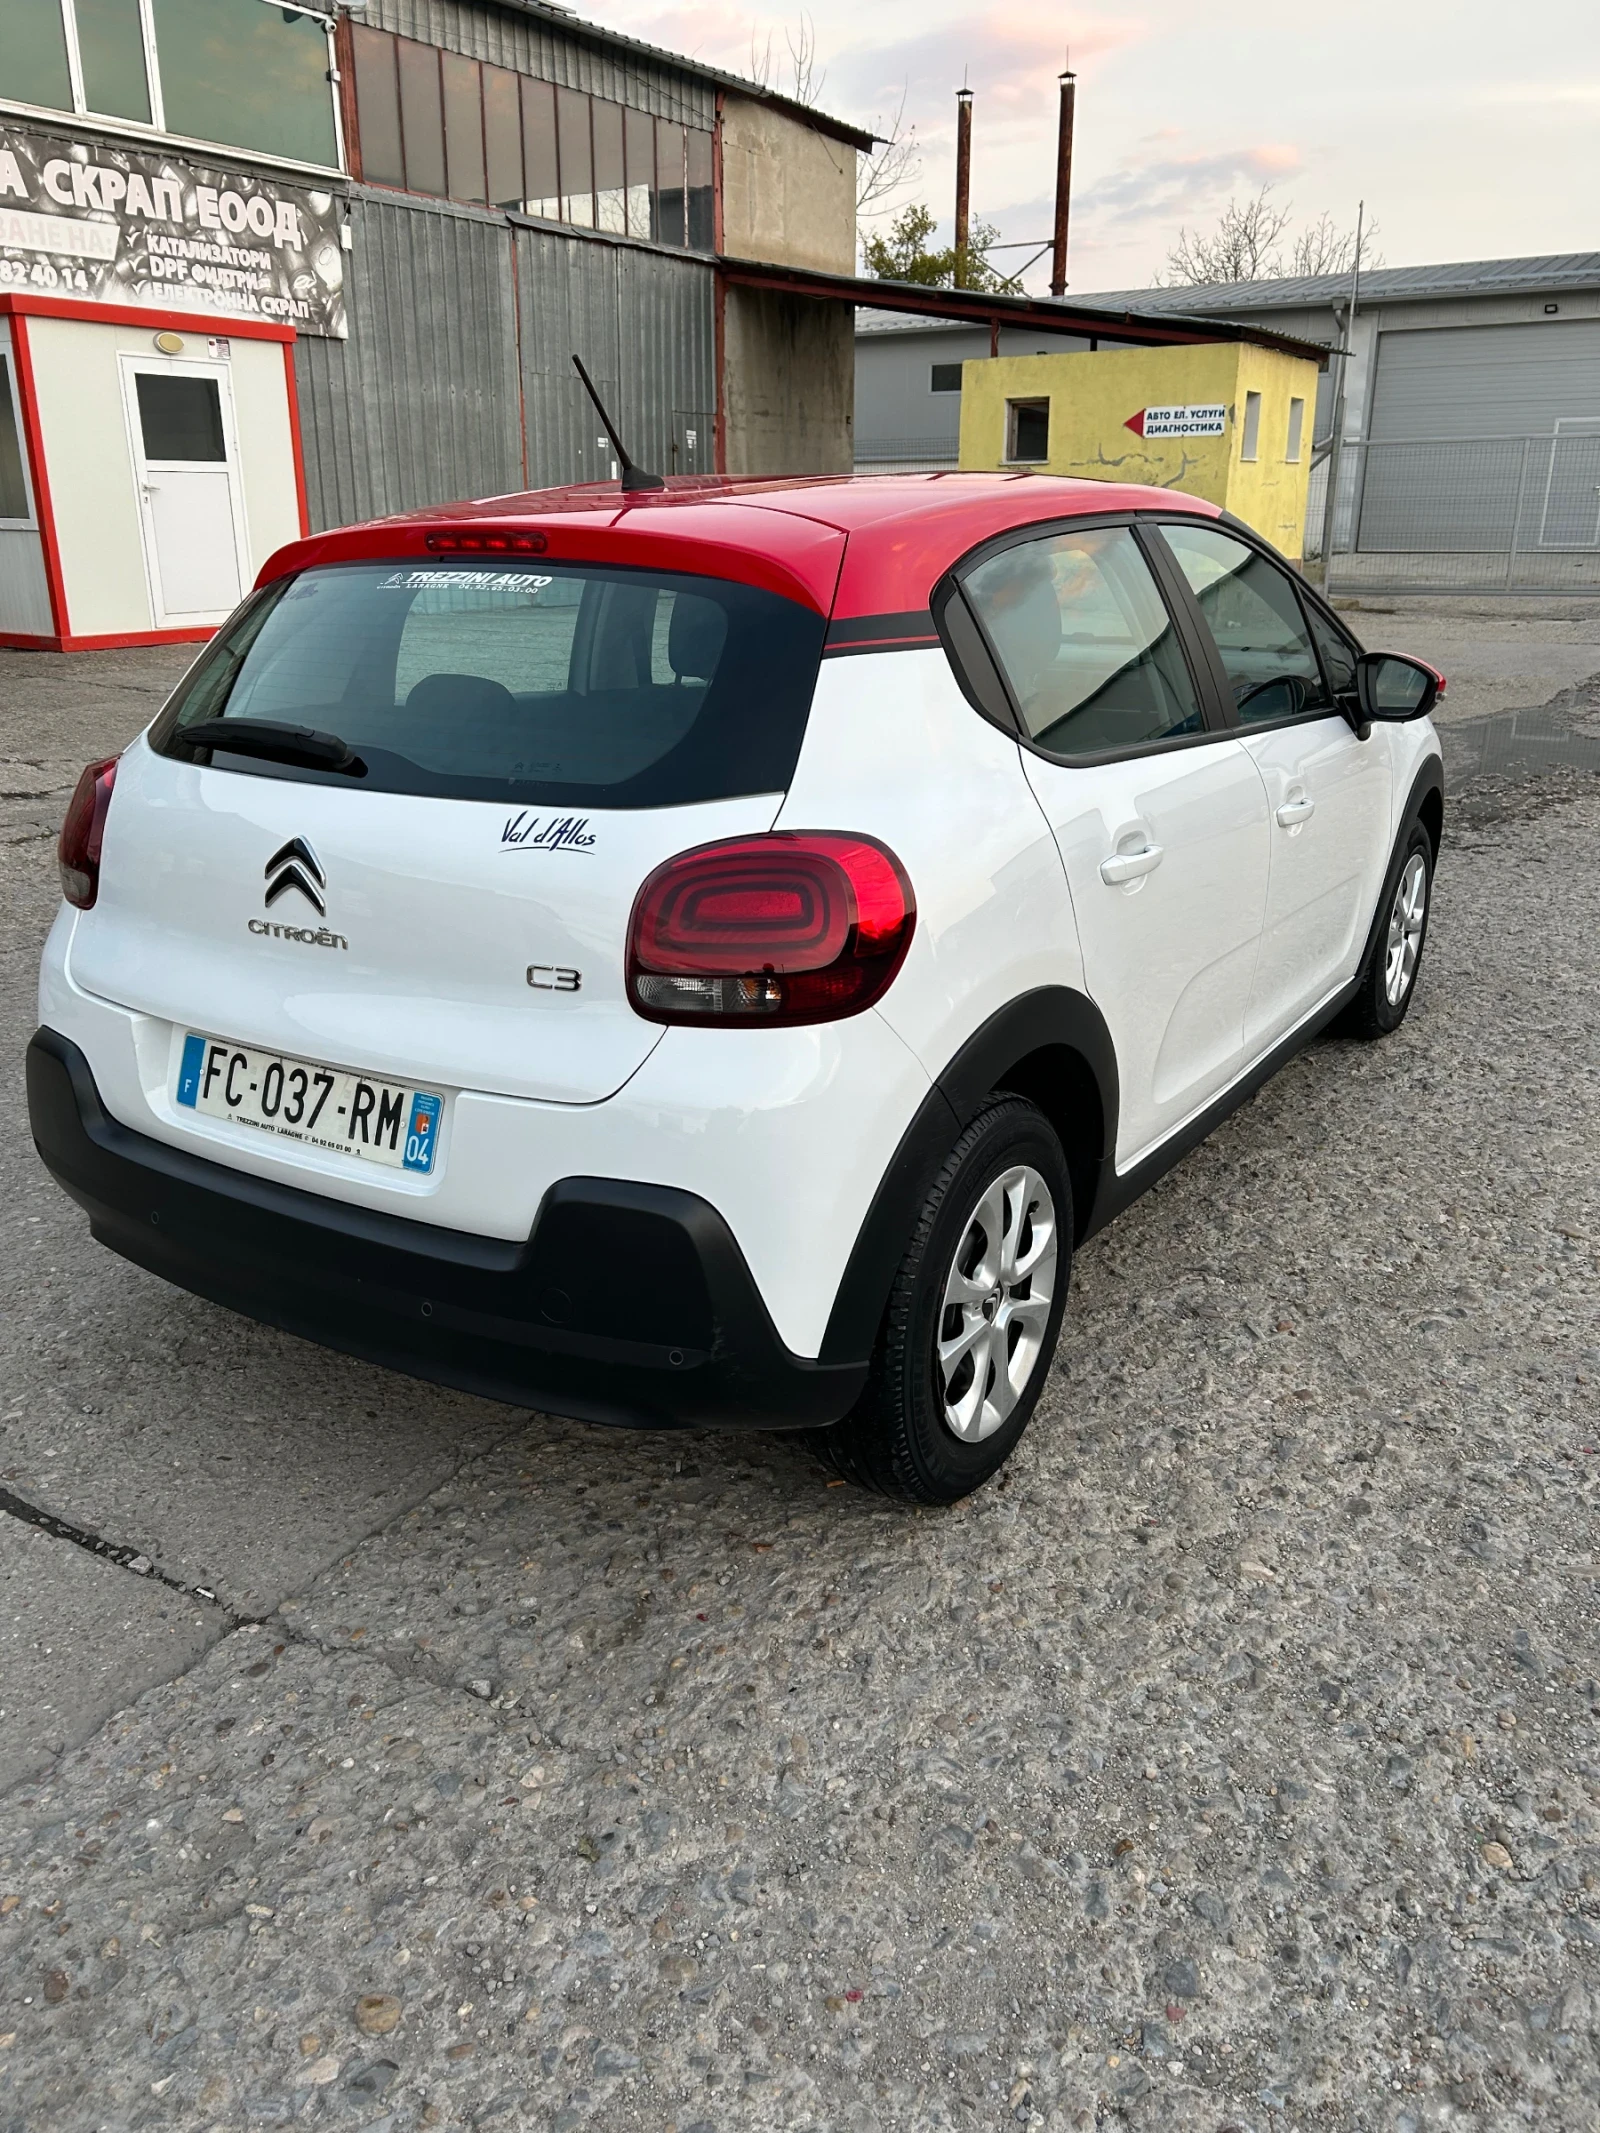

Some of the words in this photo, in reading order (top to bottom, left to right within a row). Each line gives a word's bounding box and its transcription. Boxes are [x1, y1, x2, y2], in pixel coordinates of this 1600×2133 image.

[43, 158, 183, 223] СКРАП
[196, 186, 302, 251] ЕООД
[147, 234, 272, 270] КАТАЛИЗАТОРИ
[31, 263, 58, 288] 40
[61, 267, 88, 291] 14
[150, 255, 188, 280] DPF
[191, 264, 259, 291] ФИЛТРИ
[261, 296, 309, 318] СКРАП
[1146, 411, 1170, 420] АВТО
[1174, 411, 1188, 419] ЕЛ.
[1190, 409, 1225, 419] УСЛУГИ
[1146, 423, 1222, 435] ДИАГНОСТИКА
[406, 571, 497, 584] TREZZINI
[493, 573, 553, 587] AUTO
[501, 809, 540, 843] Val
[533, 817, 597, 851] d'Allos
[527, 965, 582, 992] C3
[184, 1079, 192, 1093] F
[203, 1045, 405, 1151] FC-037-RM
[406, 1135, 429, 1165] 04
[260, 1123, 275, 1132] AUTO
